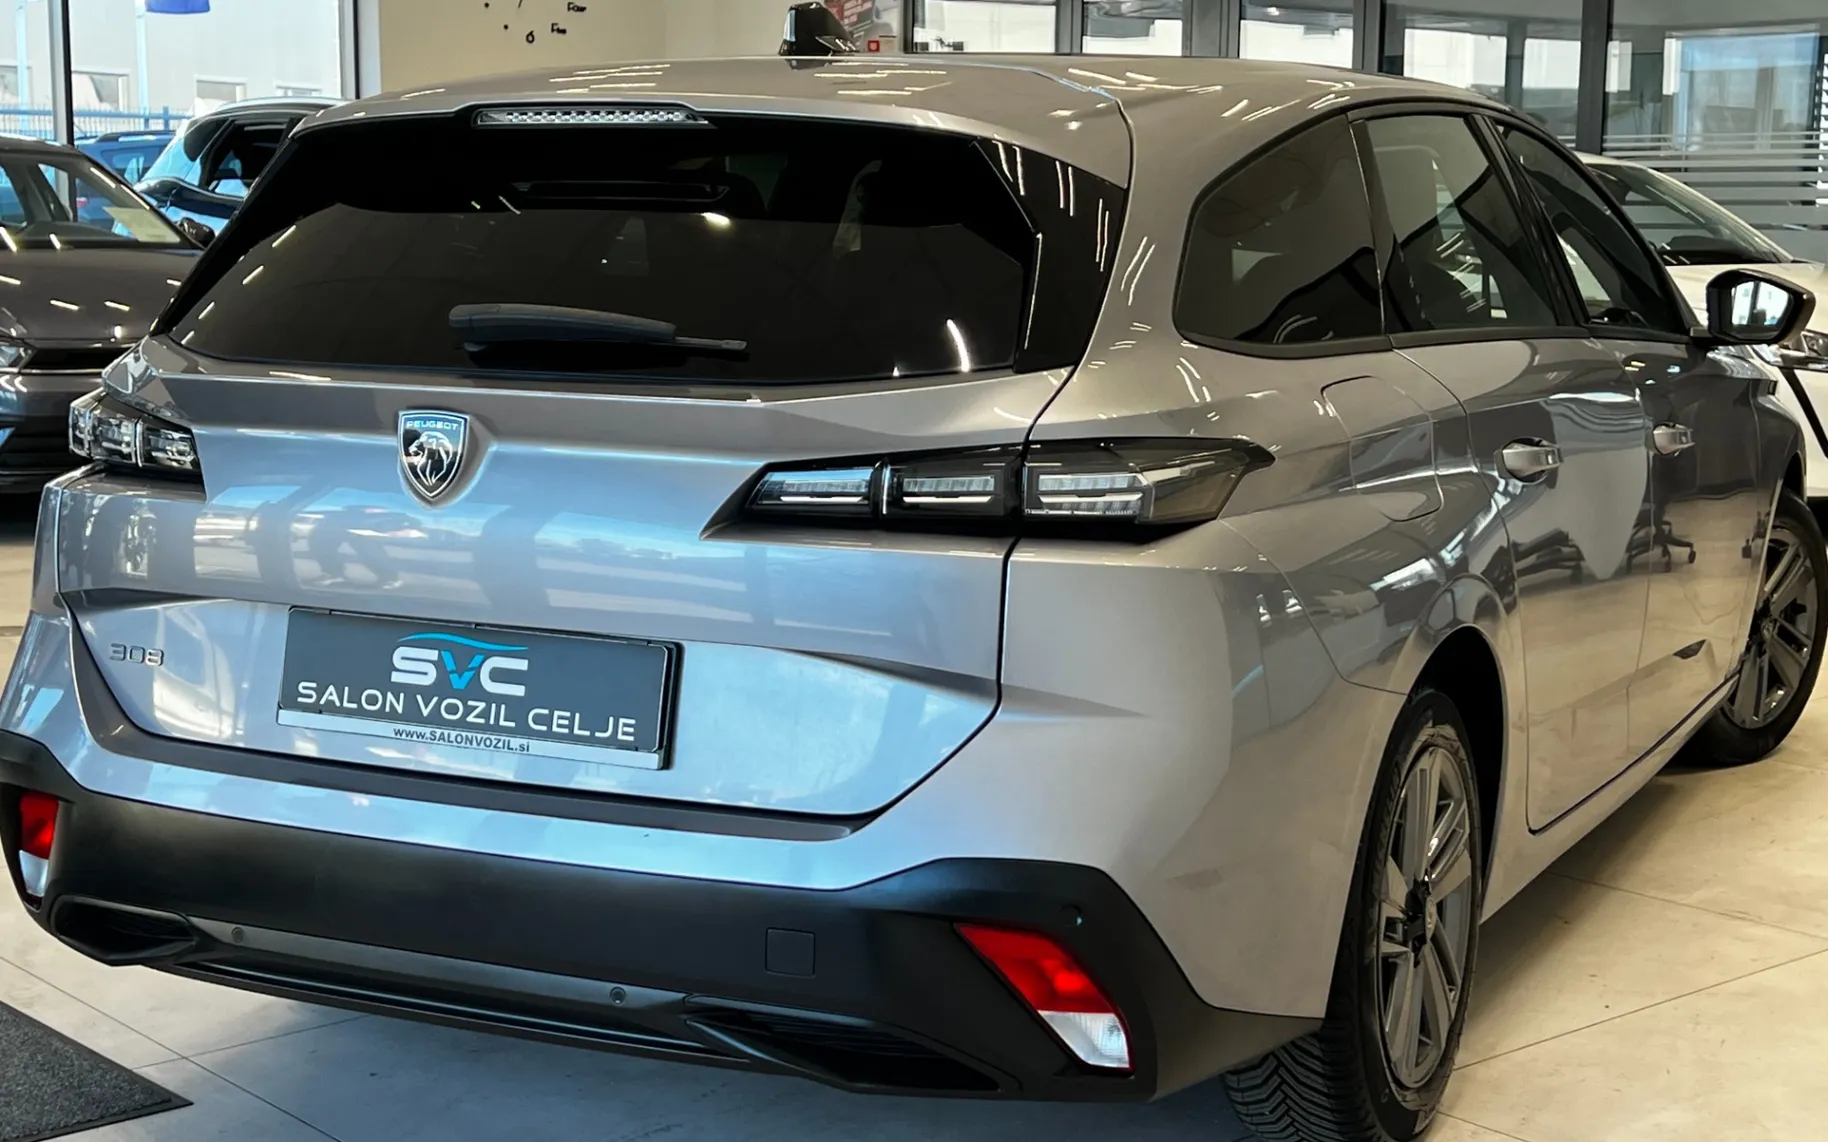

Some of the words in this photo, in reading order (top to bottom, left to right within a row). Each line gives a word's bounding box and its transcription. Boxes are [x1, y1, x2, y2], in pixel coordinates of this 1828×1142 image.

[525, 30, 535, 44] 6
[406, 420, 459, 430] PEUGEOT
[109, 643, 165, 666] 308
[390, 646, 529, 697] SVC
[297, 681, 405, 714] SALON
[416, 694, 516, 727] VOZIL
[527, 708, 636, 742] CELJE
[393, 727, 530, 753] www.SALONVOZIL.si
